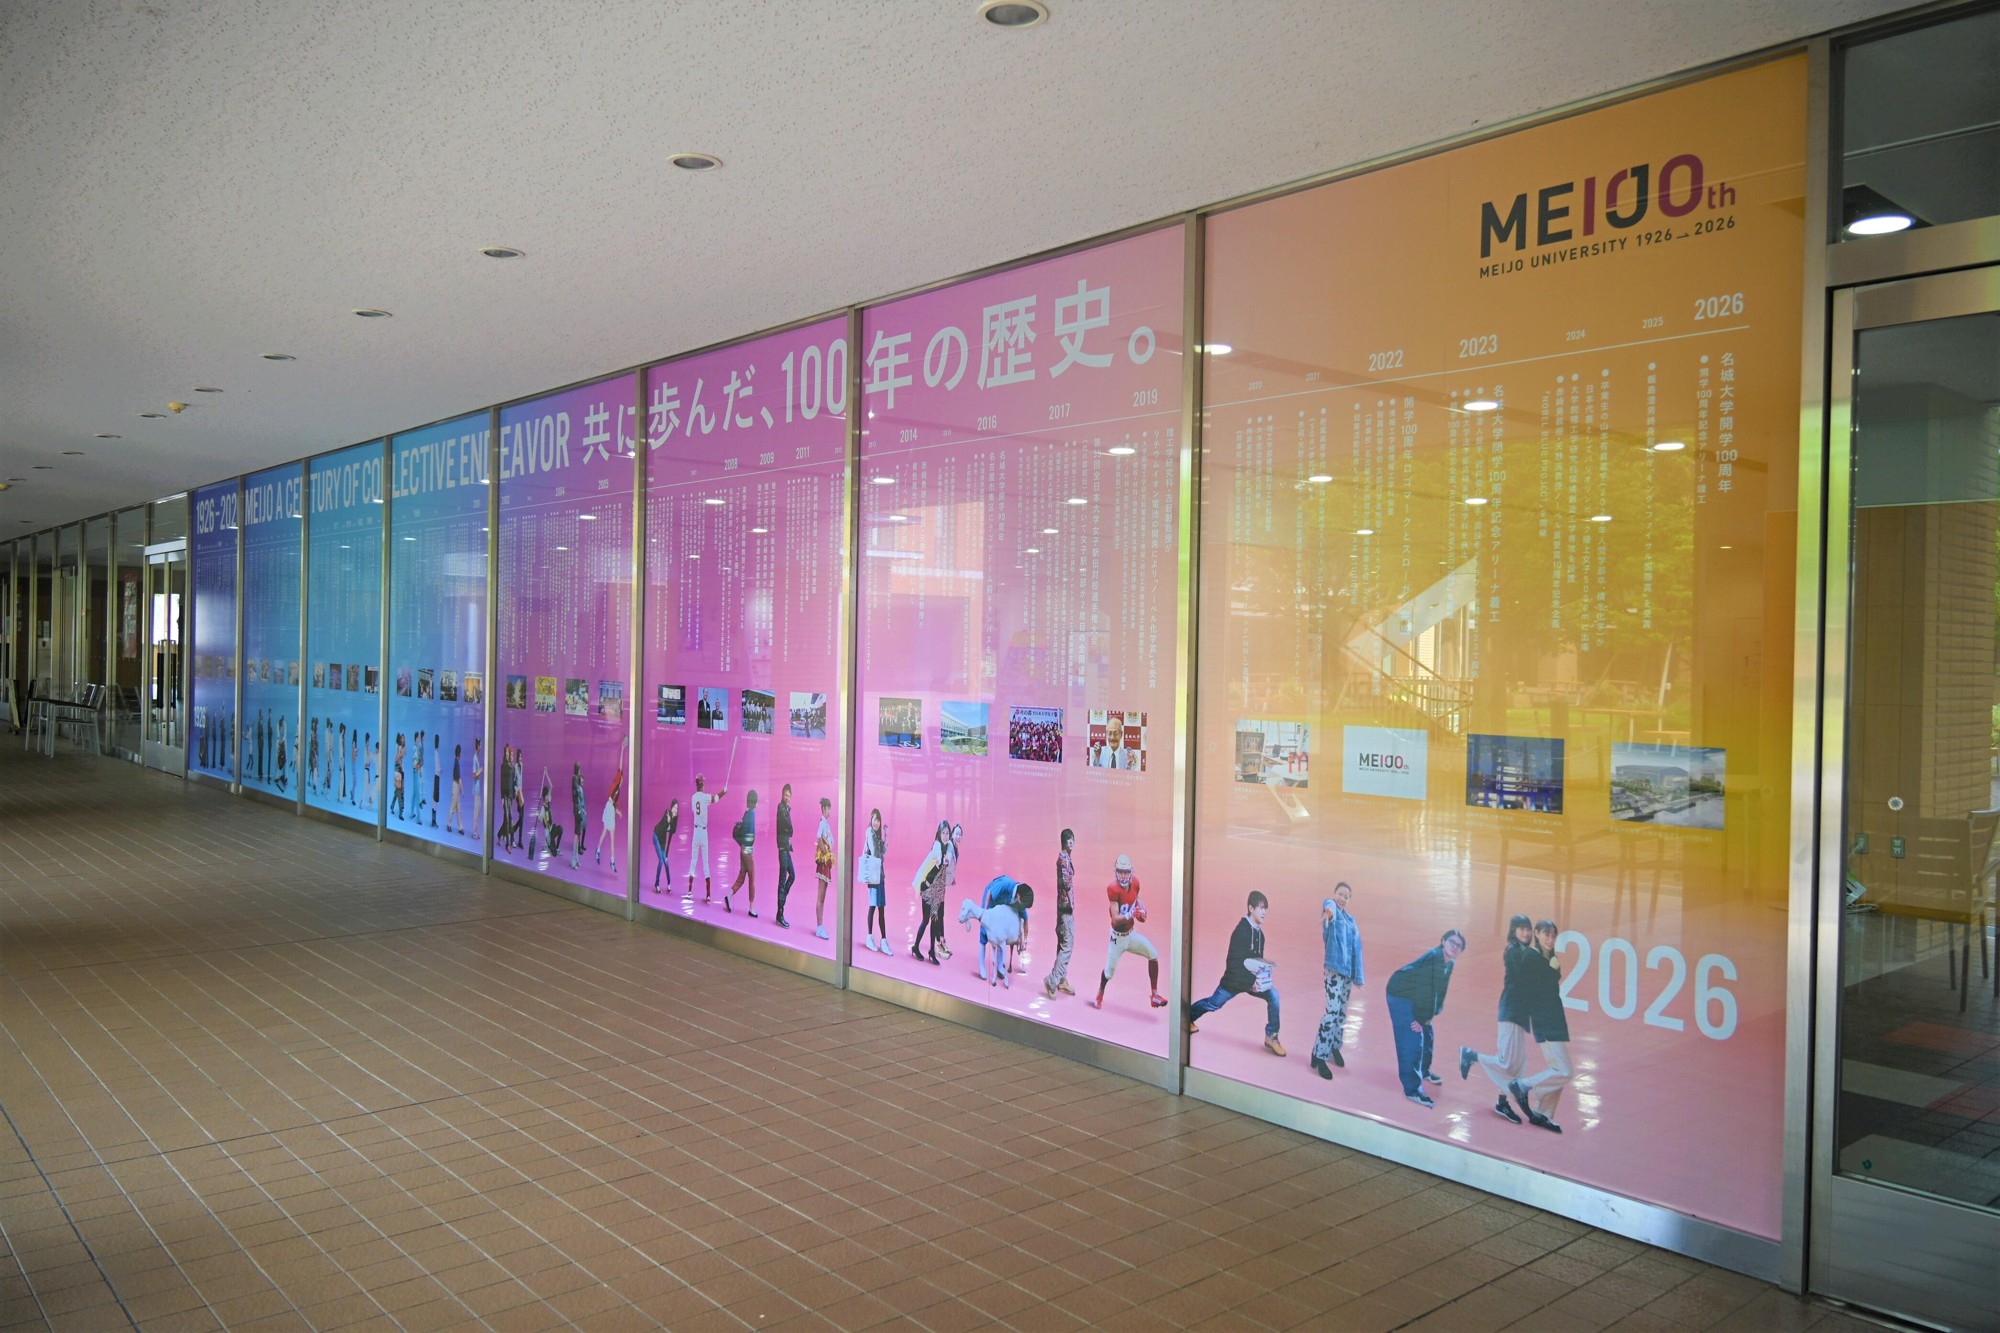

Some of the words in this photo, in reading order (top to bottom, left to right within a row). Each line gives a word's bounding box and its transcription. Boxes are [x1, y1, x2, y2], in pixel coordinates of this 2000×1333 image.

[1479, 258, 1525, 279] MEIJO
[1531, 237, 1627, 269] UNIVERSITY
[1636, 227, 1673, 247] 1926
[1694, 216, 1736, 236] 2026
[1694, 292, 1745, 322] 2026
[1641, 315, 1665, 330] 2025
[1565, 328, 1587, 342] 2024
[1458, 334, 1499, 358] 2023
[1368, 349, 1404, 372] 2022
[1305, 371, 1321, 383] 2021
[1132, 388, 1158, 408] 2019
[1048, 402, 1071, 421] 2017
[976, 415, 997, 432] 2016
[1715, 352, 1738, 494] 名城大学開学100周年
[899, 428, 918, 444] 2014
[760, 452, 775, 466] 2009
[796, 447, 810, 460] 2011
[245, 483, 274, 526] MEIJO
[276, 481, 284, 519] A
[343, 462, 361, 508] OF
[695, 801, 701, 815] 9
[1553, 930, 1738, 1042] 2026
